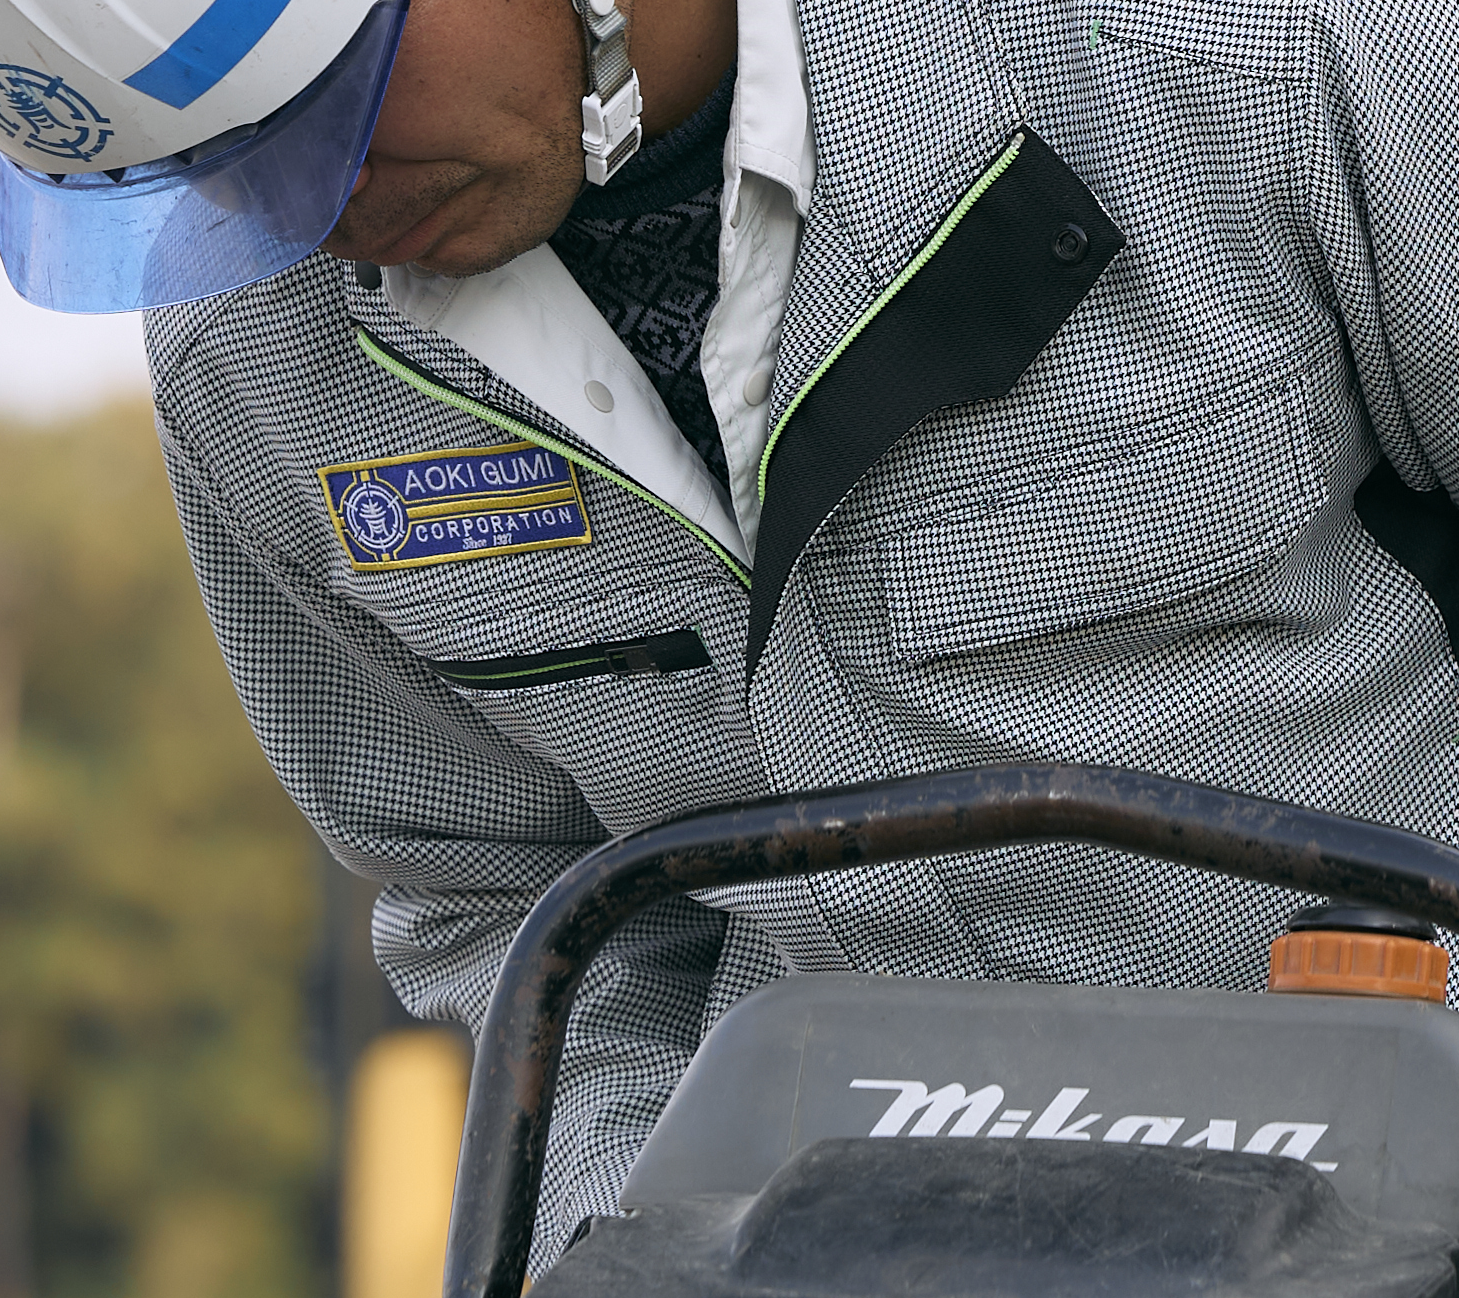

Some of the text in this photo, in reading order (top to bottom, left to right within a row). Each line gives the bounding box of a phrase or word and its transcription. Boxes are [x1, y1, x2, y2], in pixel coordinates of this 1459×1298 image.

[404, 452, 555, 496] AOKI GUMI
[415, 506, 573, 543] CORPORATION
